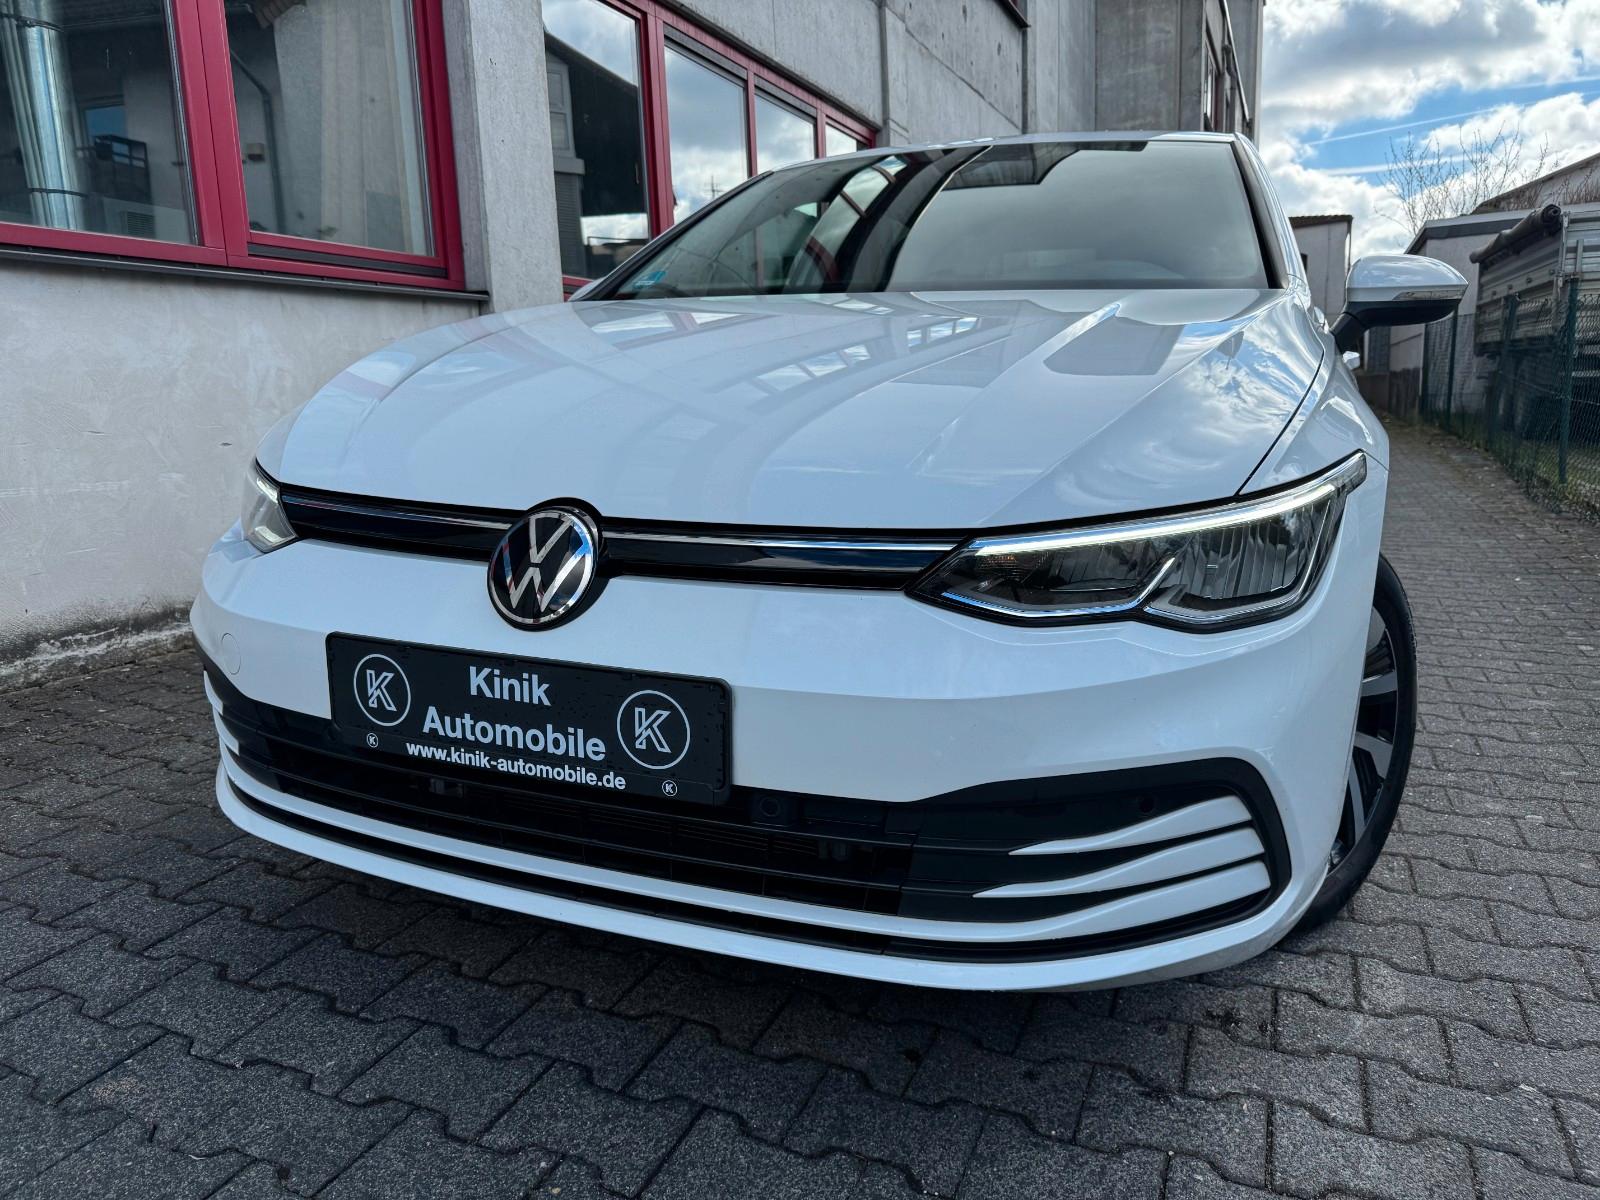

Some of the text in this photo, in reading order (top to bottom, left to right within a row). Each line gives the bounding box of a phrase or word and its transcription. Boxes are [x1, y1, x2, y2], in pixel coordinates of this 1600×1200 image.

[365, 669, 397, 712] K
[469, 665, 550, 706] Kinik
[422, 705, 606, 761] Automobile
[635, 706, 672, 754] K
[406, 741, 626, 789] www.kinik-automobile.de
